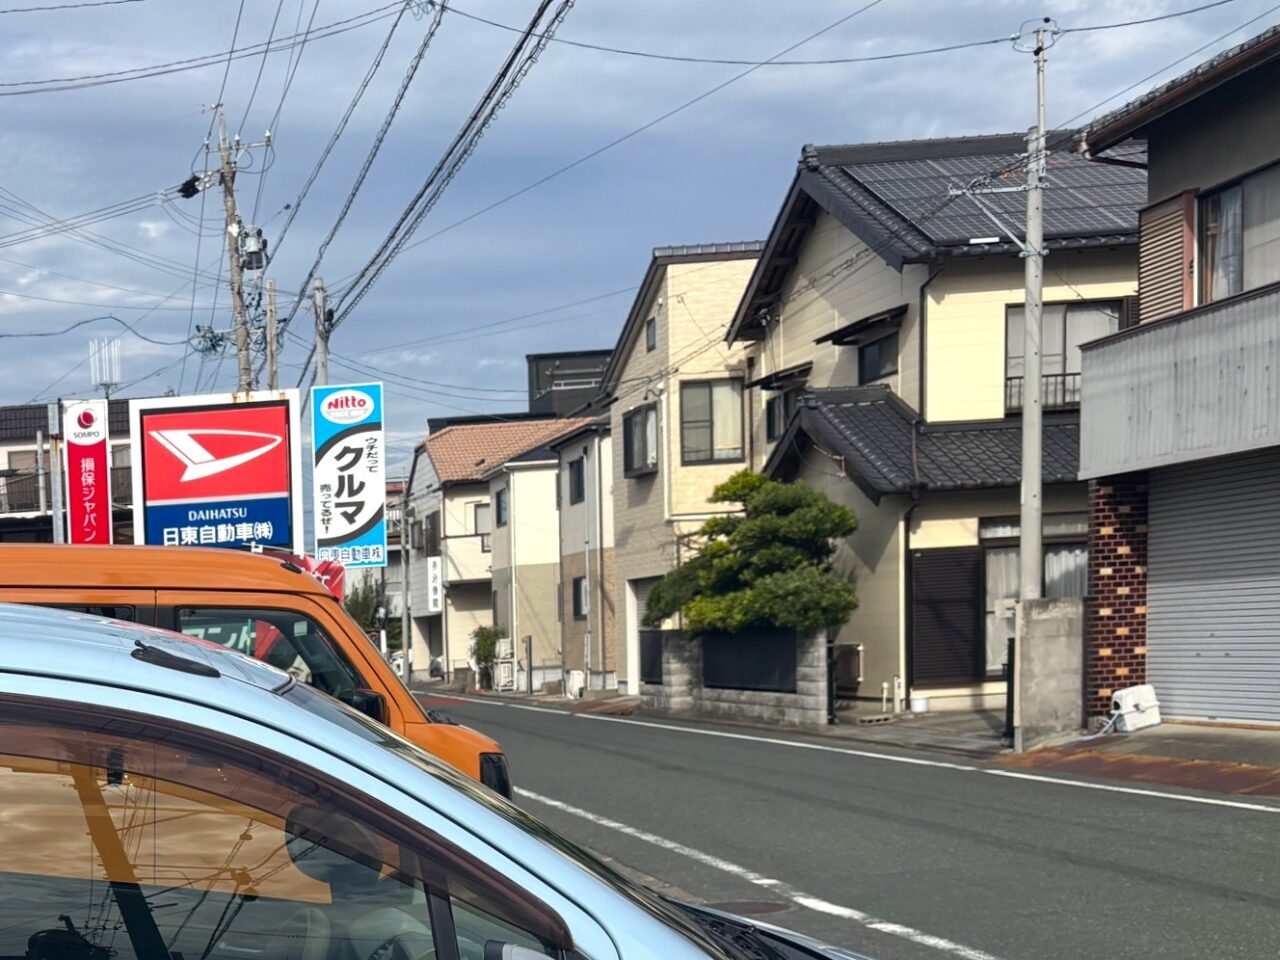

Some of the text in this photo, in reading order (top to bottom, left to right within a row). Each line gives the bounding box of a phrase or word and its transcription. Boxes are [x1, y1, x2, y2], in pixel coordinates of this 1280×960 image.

[327, 395, 367, 410] Nitto
[73, 431, 100, 439] SOMPO
[365, 437, 378, 473] ウチだって
[334, 446, 365, 525] クルマ
[81, 457, 97, 542] 損保ジャパン
[188, 507, 248, 521] DAIHATSU
